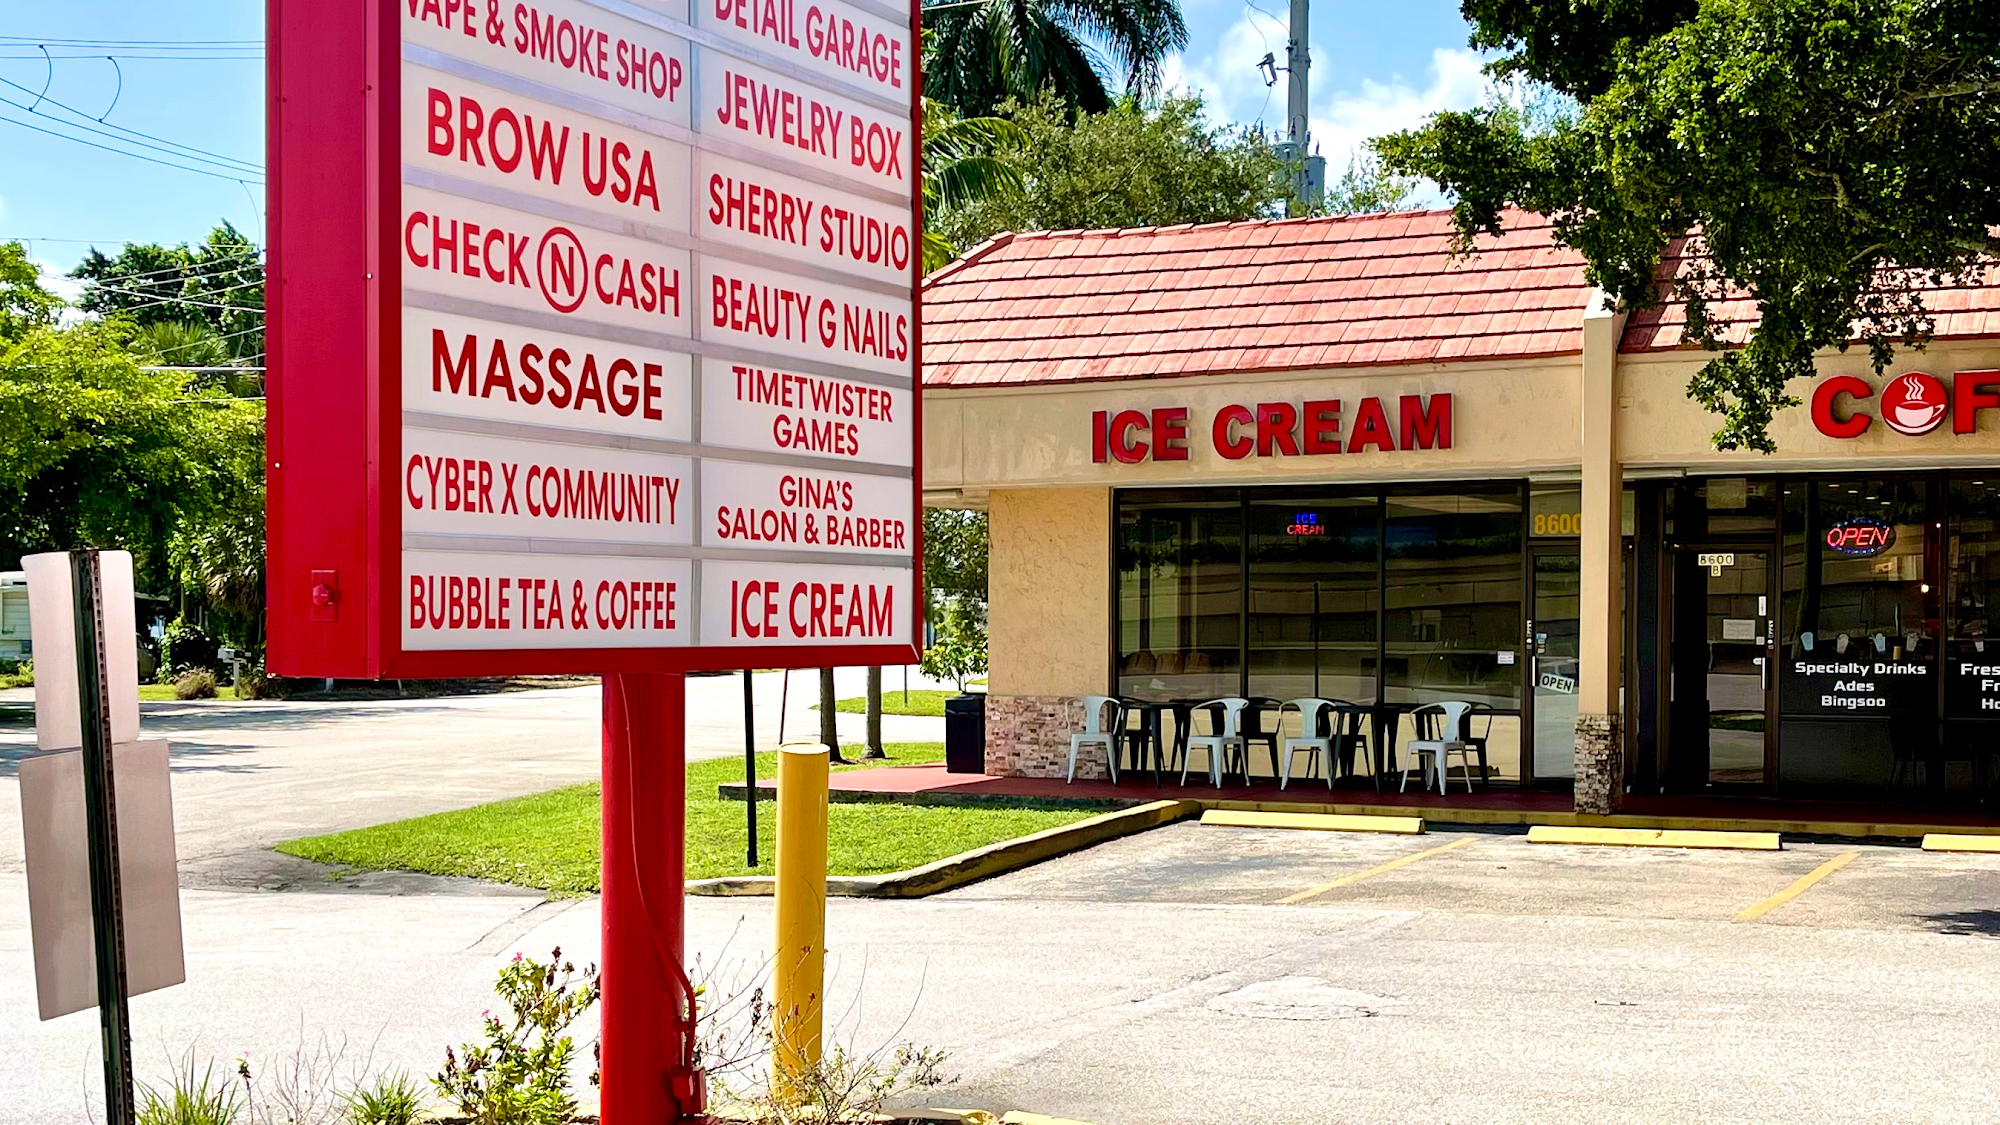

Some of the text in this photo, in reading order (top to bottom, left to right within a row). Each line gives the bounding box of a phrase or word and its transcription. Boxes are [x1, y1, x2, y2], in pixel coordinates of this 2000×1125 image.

[485, 0, 506, 48] &
[514, 3, 609, 82] SMOKE
[616, 39, 682, 102] SHOP
[806, 6, 901, 88] GARAGE
[428, 87, 661, 212] BROW USA
[717, 71, 903, 181] JEWELRY BOX
[708, 173, 909, 271] SHERRY STUDIO
[405, 211, 680, 318] CHECK N CASH
[712, 274, 908, 362] BEAUTY G NAILS
[432, 328, 663, 421] MASSAGE
[732, 366, 893, 423] TIMETWISTER
[773, 414, 859, 456] GAMES
[1092, 392, 1454, 464] ICE CREAM
[406, 454, 680, 525] CYBER X COMMUNITY
[779, 475, 853, 512] GINA'S
[717, 506, 906, 549] SALON & BARBER
[1286, 524, 1325, 535] CREAM
[1296, 513, 1317, 525] ICE
[1534, 513, 1581, 535] 8600
[1827, 526, 1890, 547] OPEN
[1700, 555, 1733, 565] 8600
[1712, 565, 1720, 575] B
[410, 575, 676, 630] BUBBLE TEA & COFFEE
[731, 580, 893, 638] ICE CREAM
[1541, 675, 1572, 692] OPEN
[1795, 662, 1927, 677] Specialty Drinks
[1833, 680, 1875, 692] Ades
[1821, 695, 1886, 710] Bingsoo
